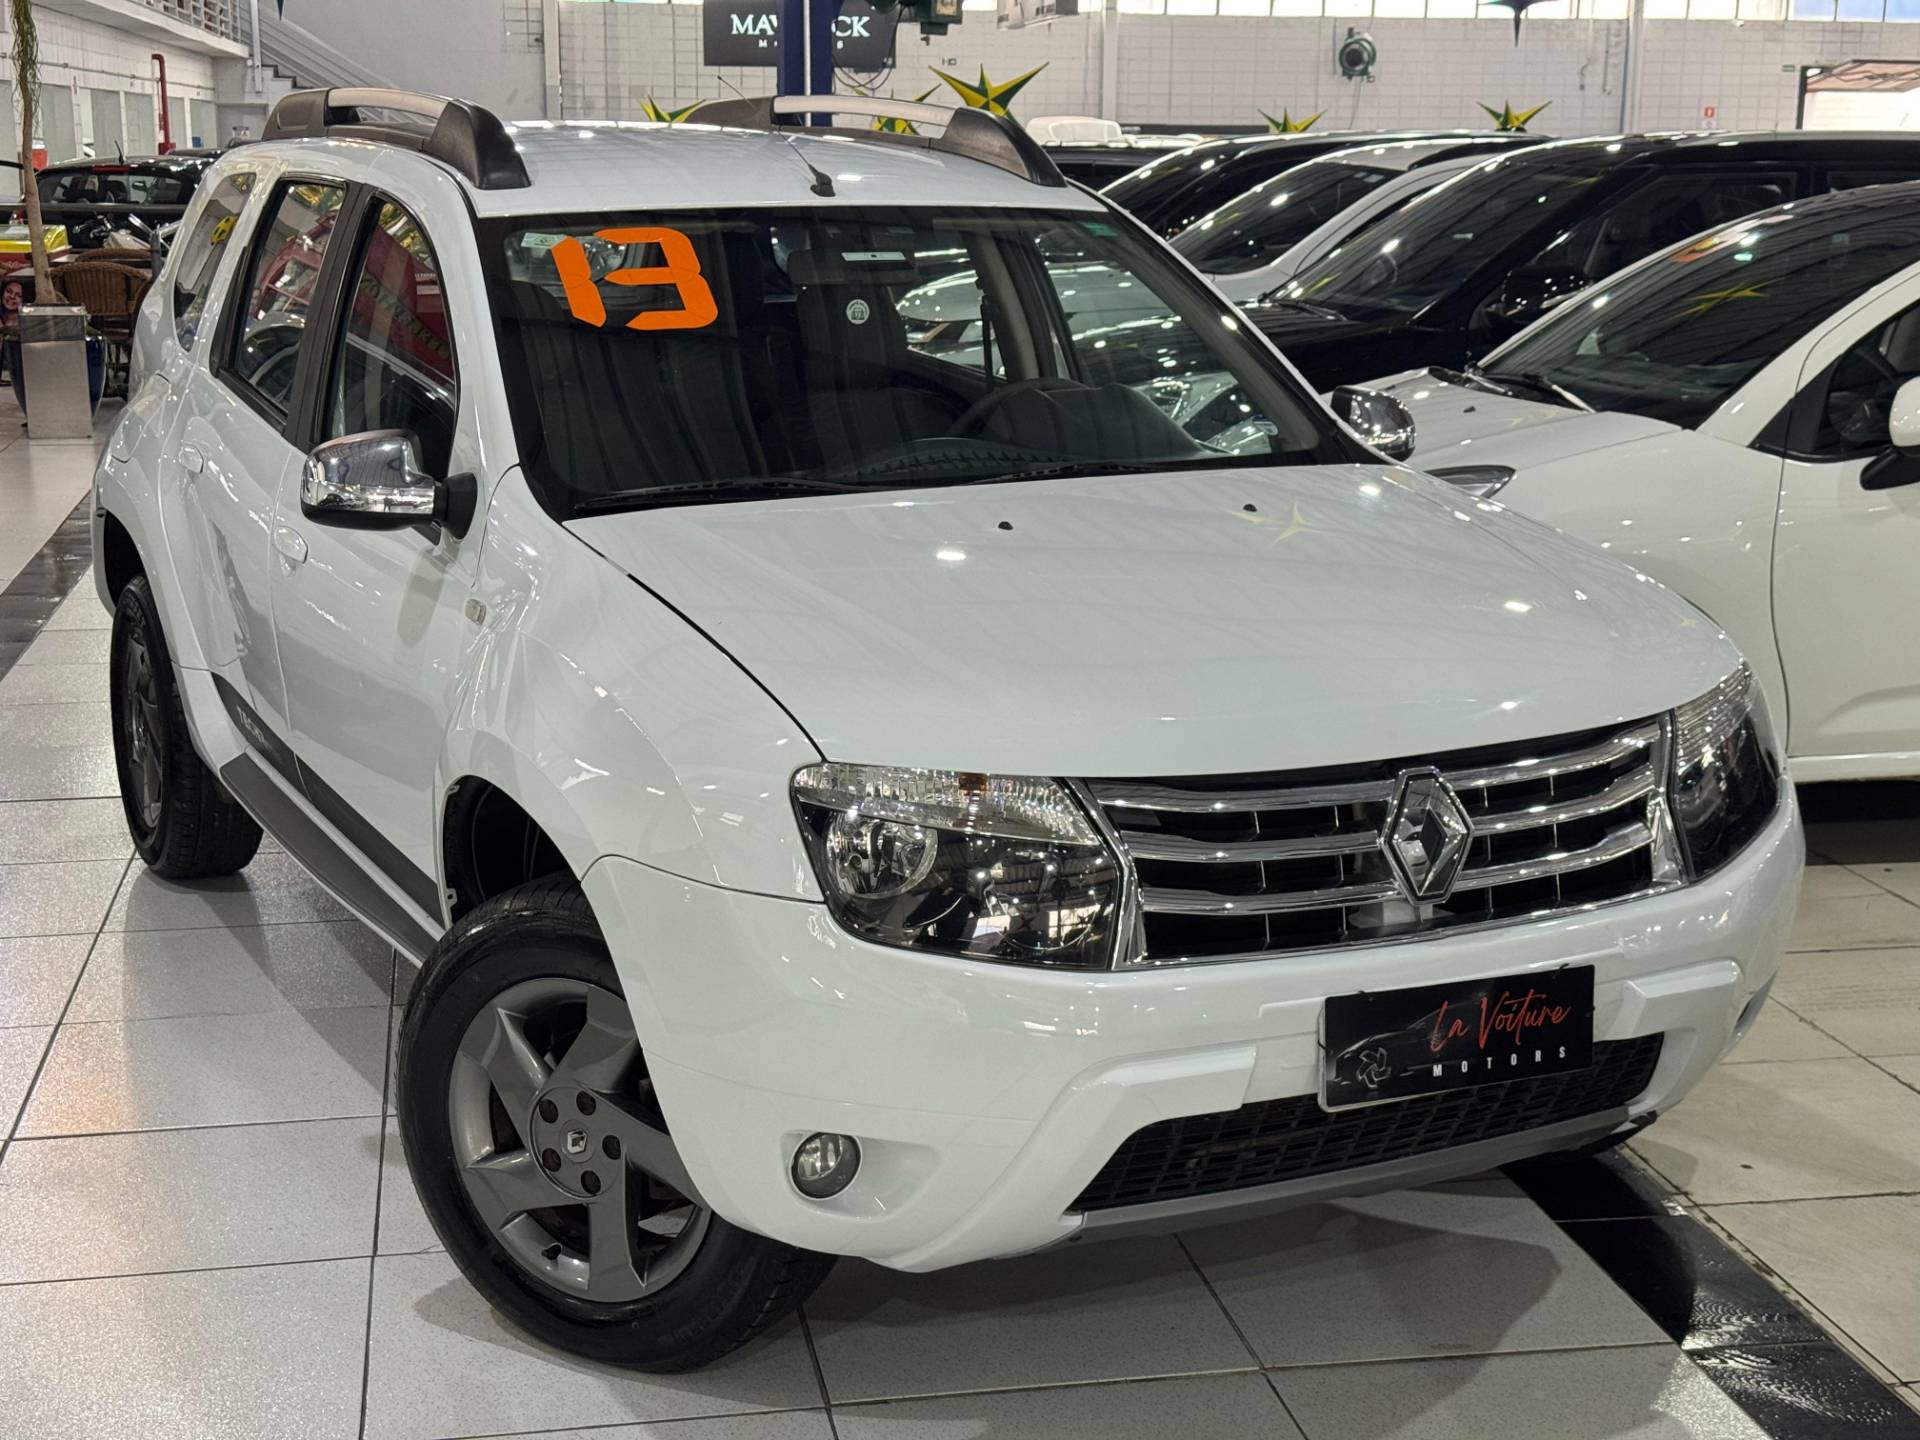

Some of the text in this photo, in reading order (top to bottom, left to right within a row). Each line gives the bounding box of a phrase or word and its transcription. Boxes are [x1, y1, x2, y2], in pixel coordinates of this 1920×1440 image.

[730, 14, 871, 37] MACK
[551, 227, 718, 331] 13
[1430, 988, 1572, 1053] La Voiture
[1432, 1046, 1566, 1077] MOTORS
